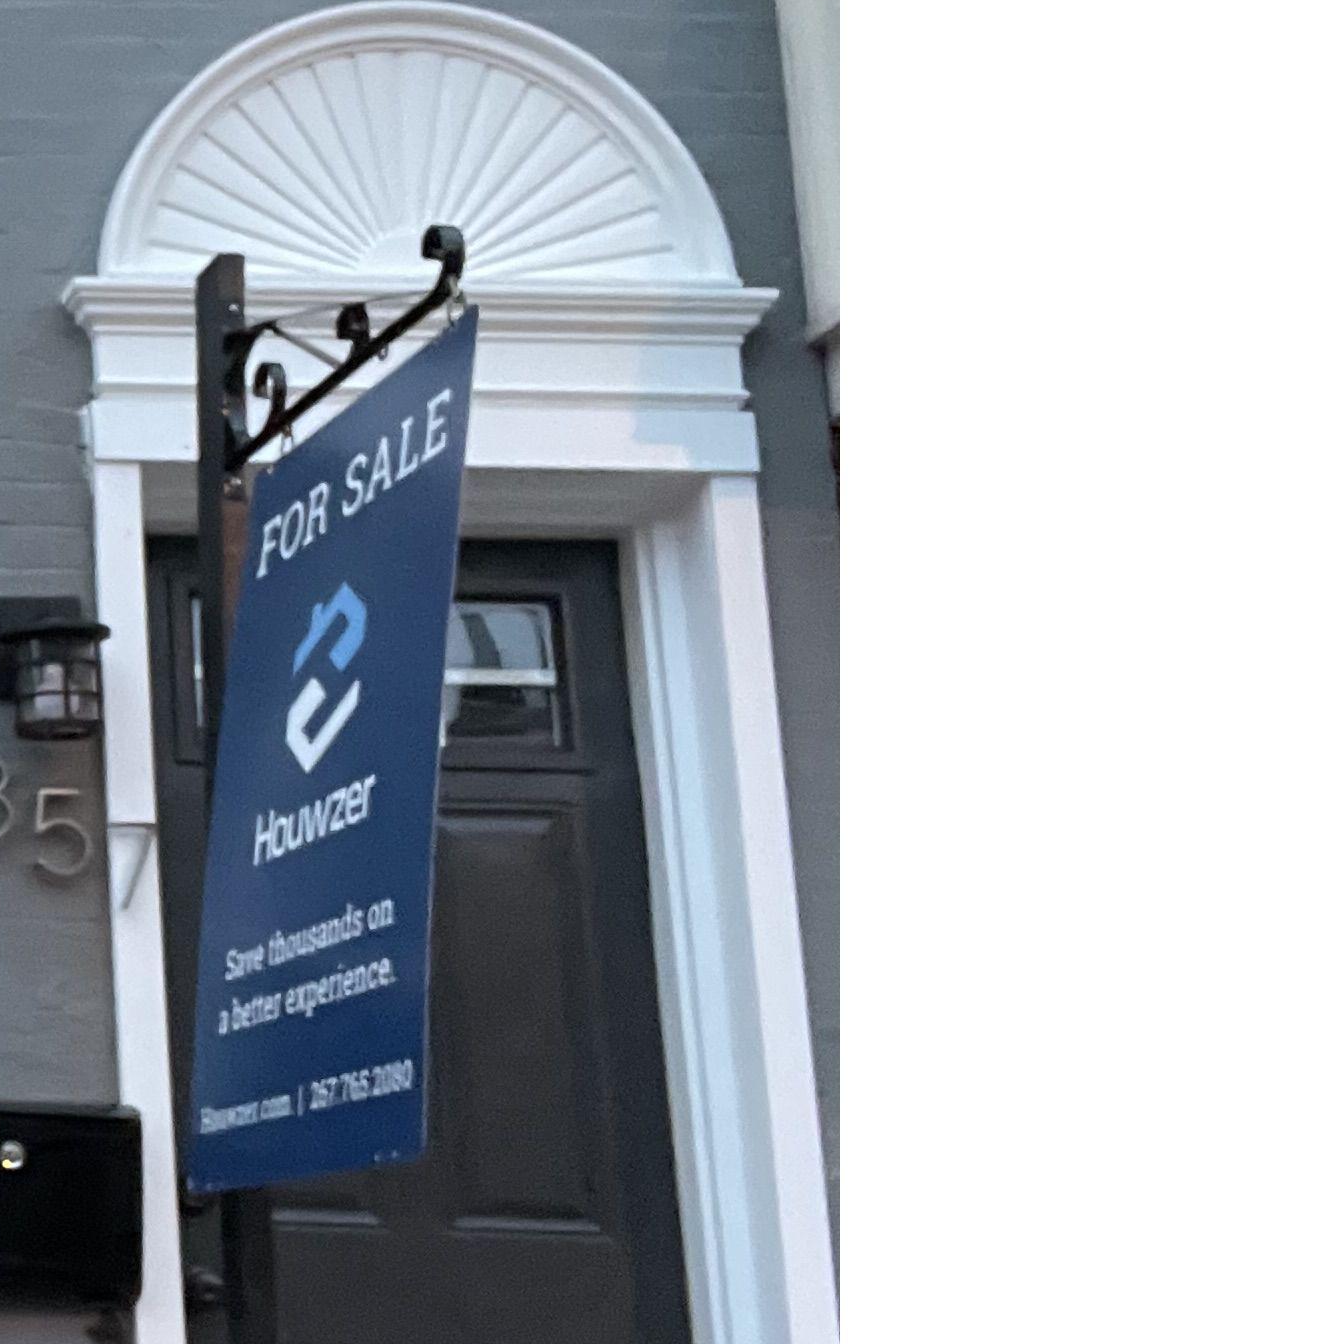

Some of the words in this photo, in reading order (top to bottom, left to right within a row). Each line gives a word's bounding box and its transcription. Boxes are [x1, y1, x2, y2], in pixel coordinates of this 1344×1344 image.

[255, 481, 330, 579] FOR
[341, 388, 452, 517] SALE
[252, 774, 377, 866] Houwzer
[225, 944, 265, 981] Save
[268, 903, 365, 966] thousands
[367, 899, 395, 931] on
[218, 1010, 229, 1035] a
[232, 997, 282, 1030] better
[285, 958, 397, 1017] experience.
